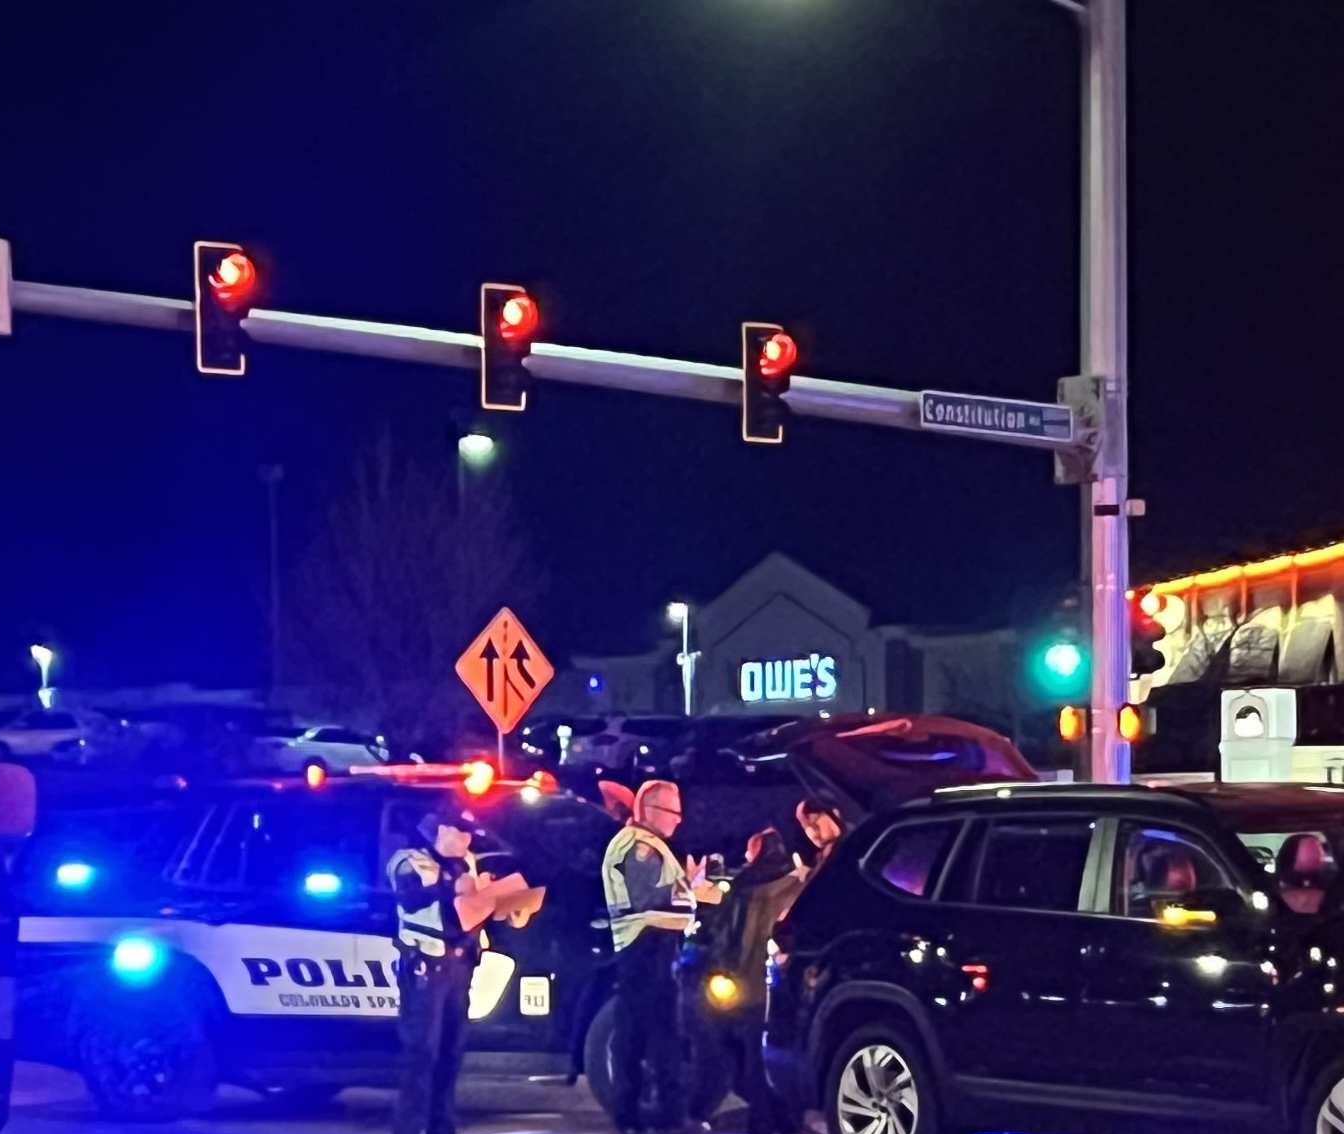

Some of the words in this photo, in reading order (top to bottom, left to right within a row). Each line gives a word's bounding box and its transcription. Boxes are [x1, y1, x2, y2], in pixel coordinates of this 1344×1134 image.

[924, 399, 1025, 430] Constitution
[241, 957, 398, 988] POLI
[278, 993, 361, 1009] COLORADO
